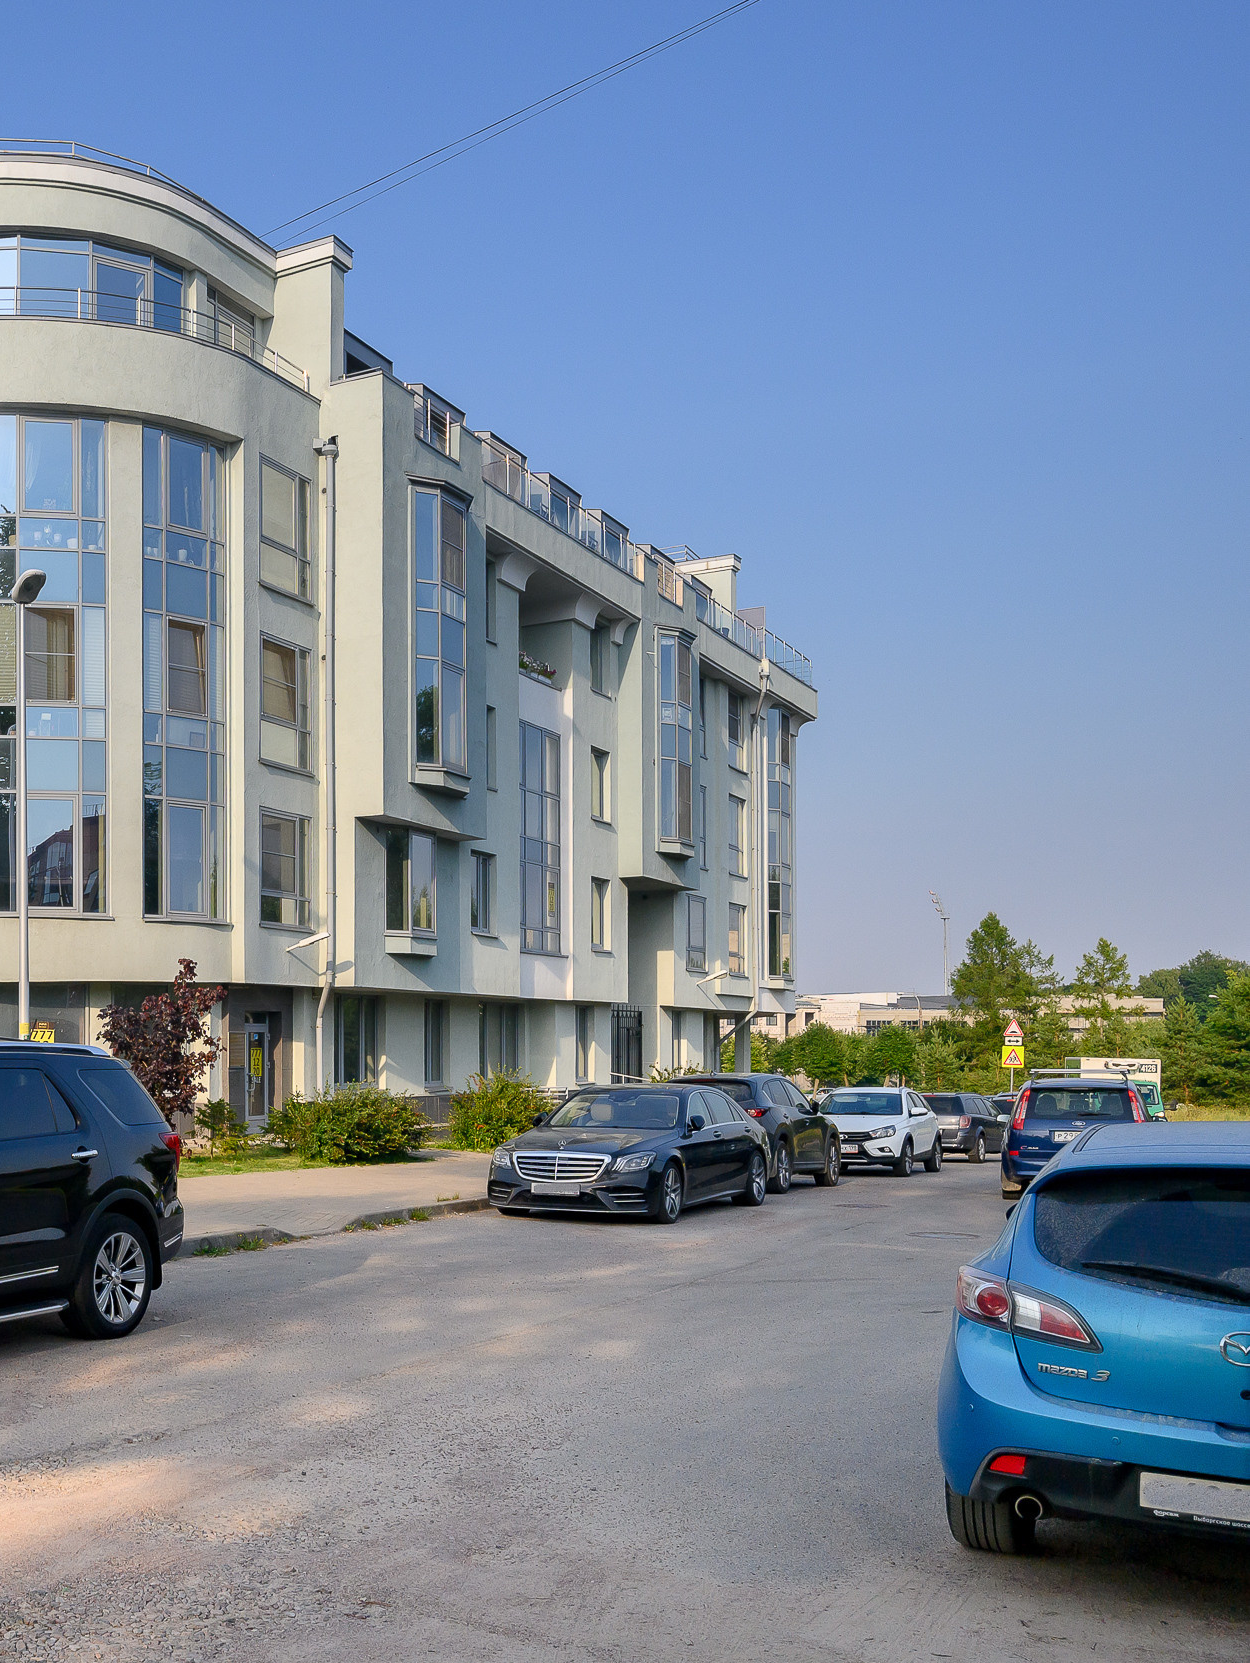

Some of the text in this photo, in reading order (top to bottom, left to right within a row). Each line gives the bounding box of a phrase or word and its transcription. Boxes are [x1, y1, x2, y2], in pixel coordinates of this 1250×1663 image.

[32, 1030, 53, 1039] 777
[251, 1048, 261, 1057] 777
[253, 1058, 260, 1066] 12
[1140, 1064, 1156, 1073] 4126
[1090, 1369, 1111, 1382] 3
